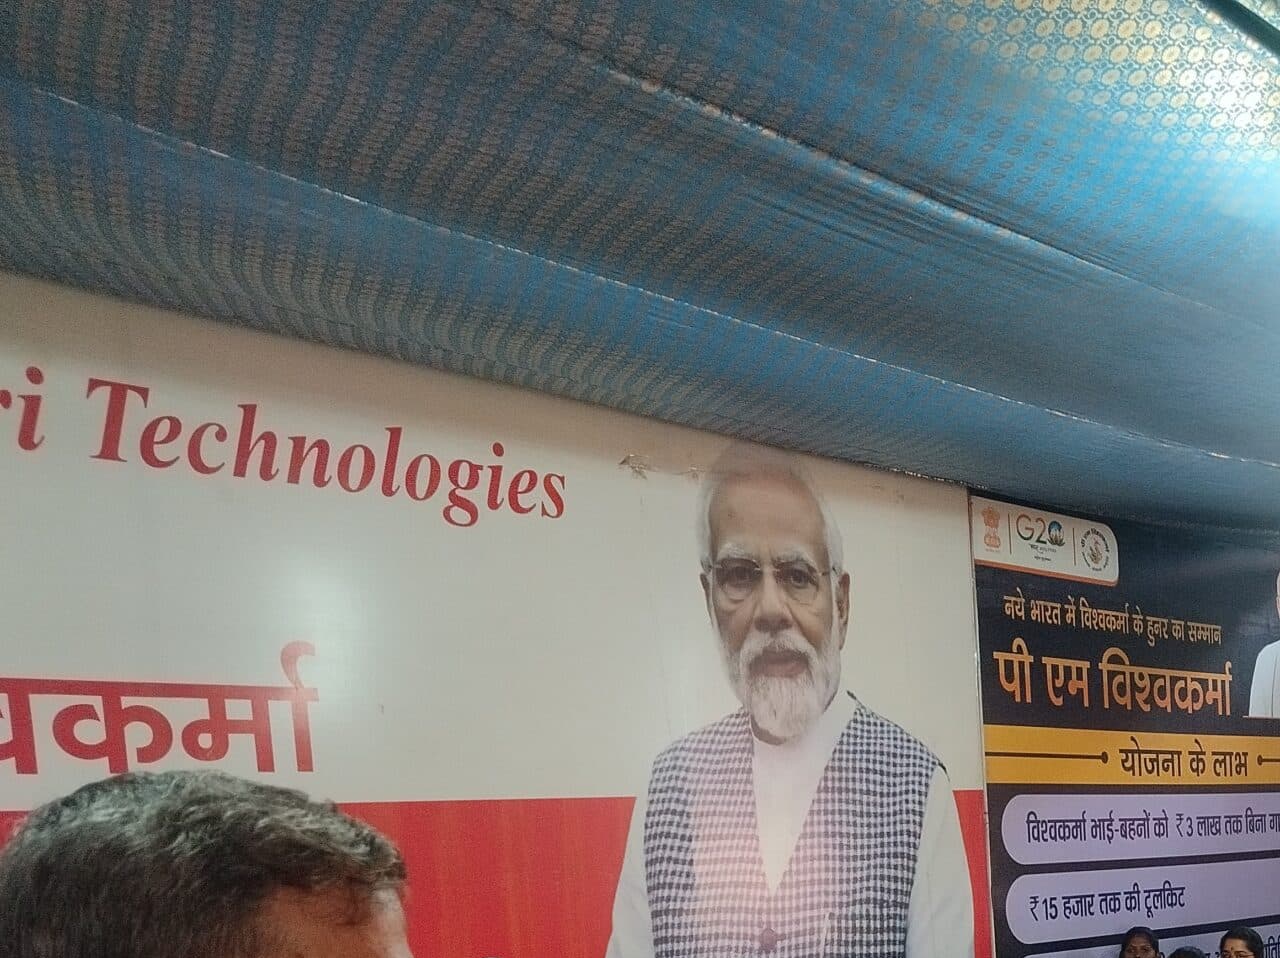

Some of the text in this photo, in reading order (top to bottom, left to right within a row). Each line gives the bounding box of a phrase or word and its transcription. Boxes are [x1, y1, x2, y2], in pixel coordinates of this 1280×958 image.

[86, 377, 567, 527] Technologies
[1003, 587, 1222, 647] नये भारत में विश्वकर्मा के हुनर का सम्मान
[993, 637, 1233, 717] पी एम विश्वकर्मा
[1119, 735, 1249, 777] योजना के लाभ
[1026, 810, 1087, 843] विश्वकर्मा
[1090, 808, 1151, 844] भाई-बहनों
[1152, 808, 1169, 838] को
[1196, 815, 1222, 837] लाख
[1224, 814, 1243, 836] तक
[1245, 806, 1267, 835] बिना
[1062, 894, 1096, 920] हजार
[1098, 891, 1122, 916] तक
[1123, 882, 1141, 913] की
[1143, 880, 1186, 919] टूलकिट
